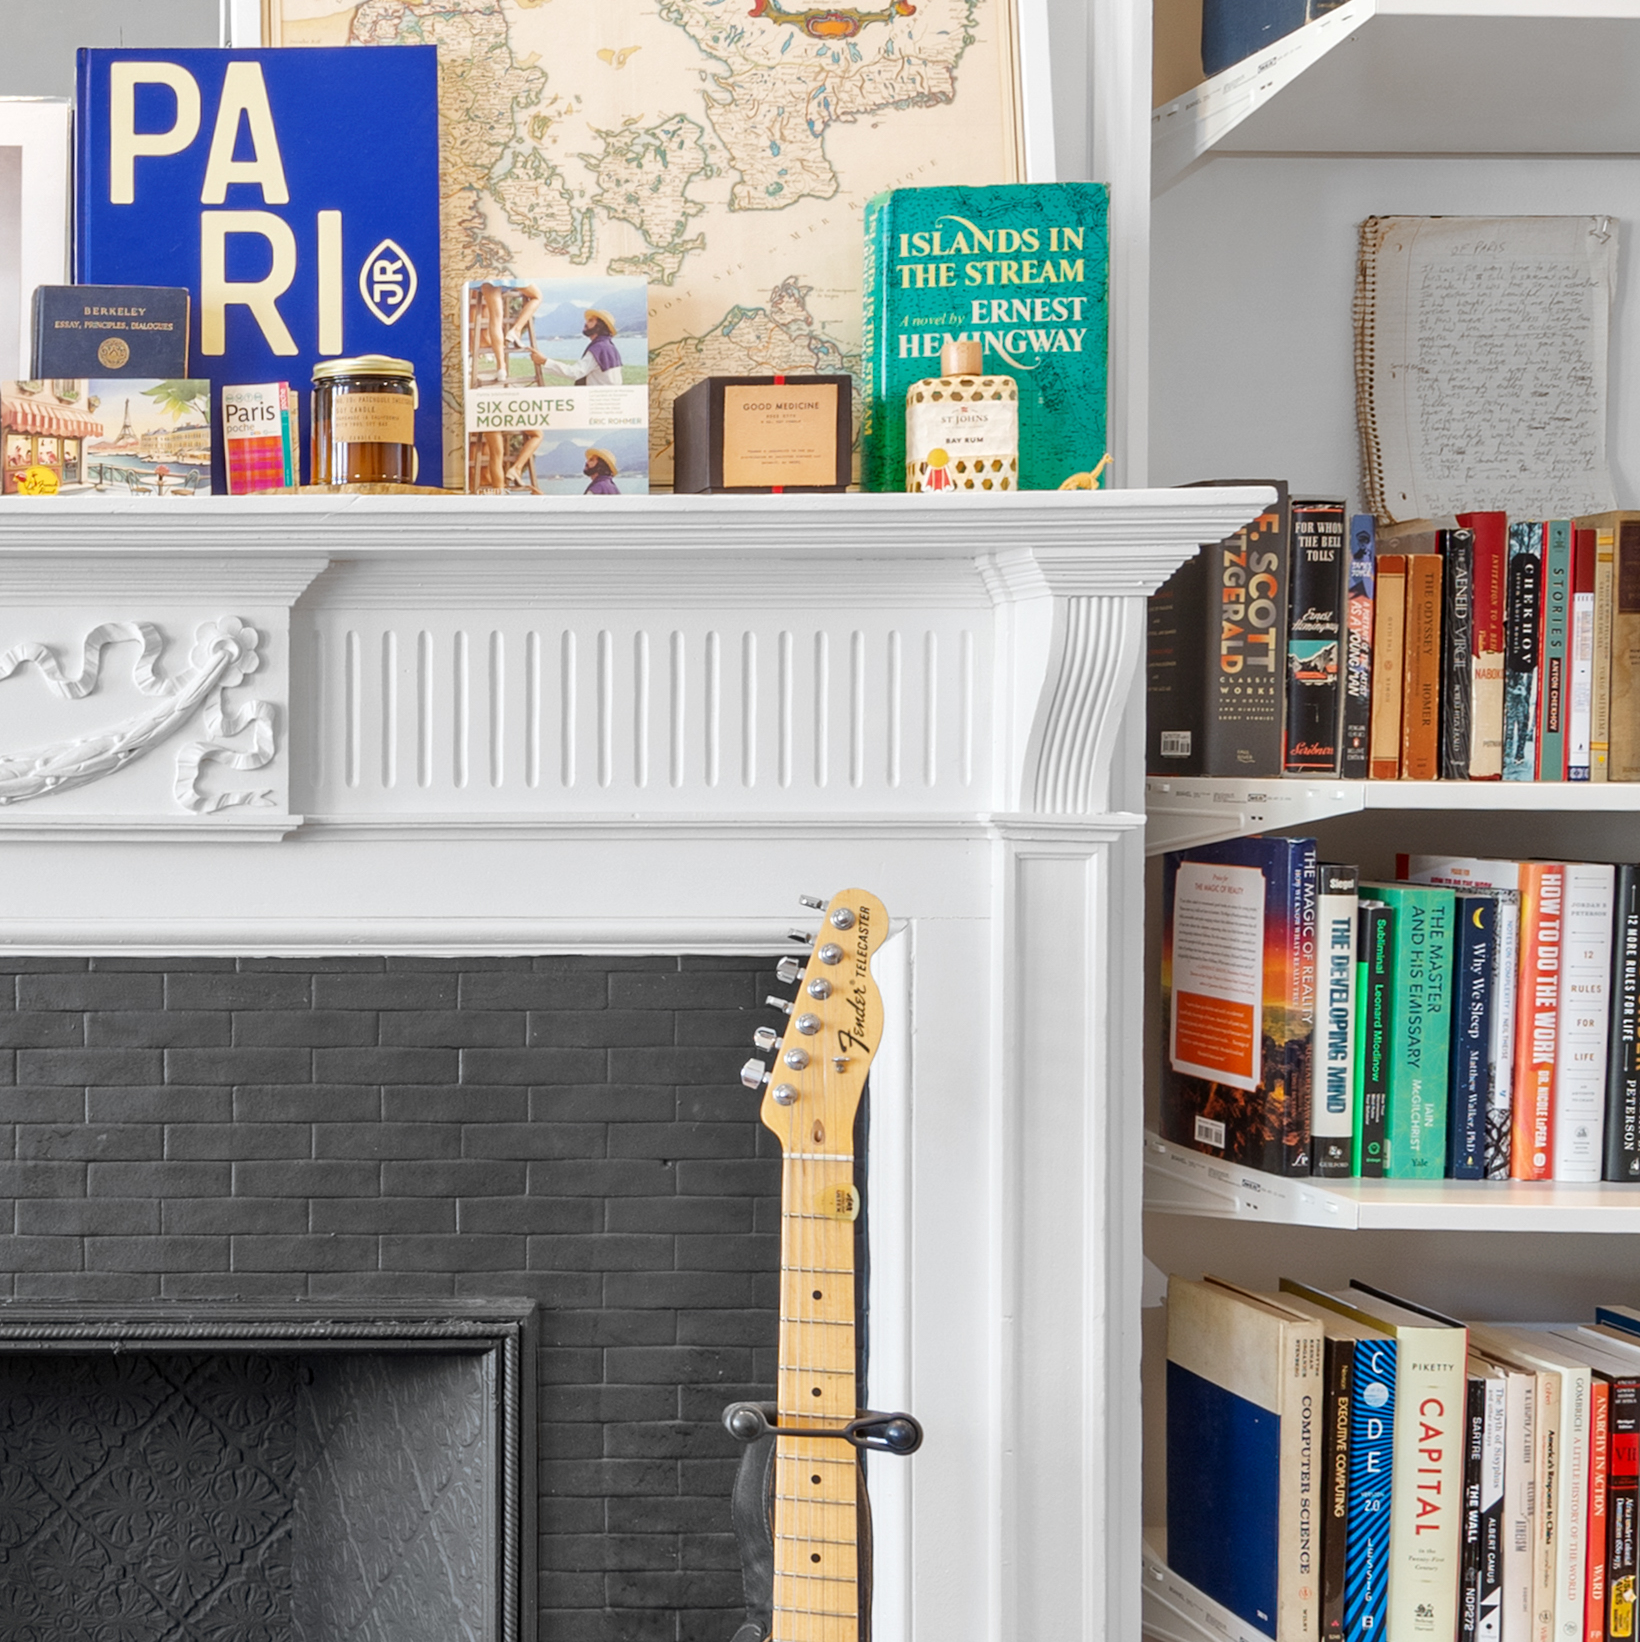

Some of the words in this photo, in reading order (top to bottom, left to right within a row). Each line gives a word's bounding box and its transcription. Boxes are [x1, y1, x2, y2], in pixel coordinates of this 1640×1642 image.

[110, 61, 290, 204] PA
[899, 215, 1040, 258] ISLANDS
[1049, 227, 1085, 252] IN
[200, 210, 343, 356] RI
[373, 259, 404, 304] JR
[896, 263, 957, 289] THE
[964, 259, 1085, 286] STREAM
[84, 306, 146, 316] BERKELEY
[899, 316, 910, 327] A
[912, 314, 947, 326] novel
[949, 313, 965, 329] by
[971, 297, 1087, 324] ERNEST
[226, 402, 275, 423] Paris
[476, 401, 503, 414] SIX
[507, 399, 576, 413] CONTES
[476, 413, 550, 428] MORAUX
[588, 416, 607, 425] ÉRIC
[608, 417, 643, 425] ROHMER
[742, 402, 772, 412] GOOD
[775, 401, 820, 410] MEDICINE
[941, 415, 953, 423] ST
[955, 414, 988, 424] JOHNS
[1299, 537, 1318, 547] THE
[1321, 537, 1341, 547] BELL
[1307, 550, 1334, 562] TOLLS
[1424, 572, 1434, 597] THE
[1302, 608, 1332, 621] Ernest
[1522, 564, 1534, 663] CHEKHOV
[1550, 568, 1564, 649] STORIES
[1423, 601, 1433, 656] ODYSSEY
[1453, 623, 1467, 671] VIRGIL
[1219, 676, 1275, 684] CLASSIC
[1220, 686, 1275, 695] WORKS
[1422, 683, 1431, 726] HOMER
[1539, 874, 1561, 915] HOW
[1331, 917, 1351, 950] THE
[1411, 906, 1425, 945] AND
[1430, 906, 1445, 939] THE
[1538, 919, 1560, 942] TO
[855, 906, 870, 978] TELECASTER
[1537, 946, 1559, 971] DO
[1410, 950, 1424, 978] HIS
[1470, 943, 1486, 975] Why
[1427, 945, 1443, 1013] MASTER
[1471, 978, 1485, 1000] We
[1535, 975, 1558, 1007] THE
[1571, 984, 1602, 994] RULES
[837, 985, 870, 1054] Fender
[1327, 955, 1350, 1061] DEVELOPING
[1468, 1002, 1484, 1039] Sleep
[1576, 1018, 1595, 1027] FOR
[1407, 984, 1423, 1068] EMISSARY
[1533, 1011, 1556, 1064] WORK
[1574, 1053, 1595, 1062] LIFE
[1326, 1066, 1348, 1114] MIND
[1623, 1079, 1637, 1151] PETERSON
[1412, 1363, 1454, 1371] PIKETTY
[1336, 1397, 1349, 1451] EXECUTIVE
[1471, 1417, 1482, 1460] SARTRE
[1595, 1395, 1607, 1453] ANARCHY
[1301, 1395, 1312, 1493] COMPUTER
[1415, 1397, 1445, 1536] CAPITAL
[1595, 1456, 1606, 1470] IN
[1334, 1453, 1346, 1518] COMPUTING
[1468, 1483, 1480, 1510] THE
[1594, 1472, 1605, 1516] ACTION
[1299, 1495, 1310, 1575] SCIENCE
[1466, 1513, 1479, 1545] WALL
[1592, 1564, 1604, 1600] WARD
[1463, 1587, 1475, 1632] NDP272
[1590, 1631, 1602, 1639] FP
